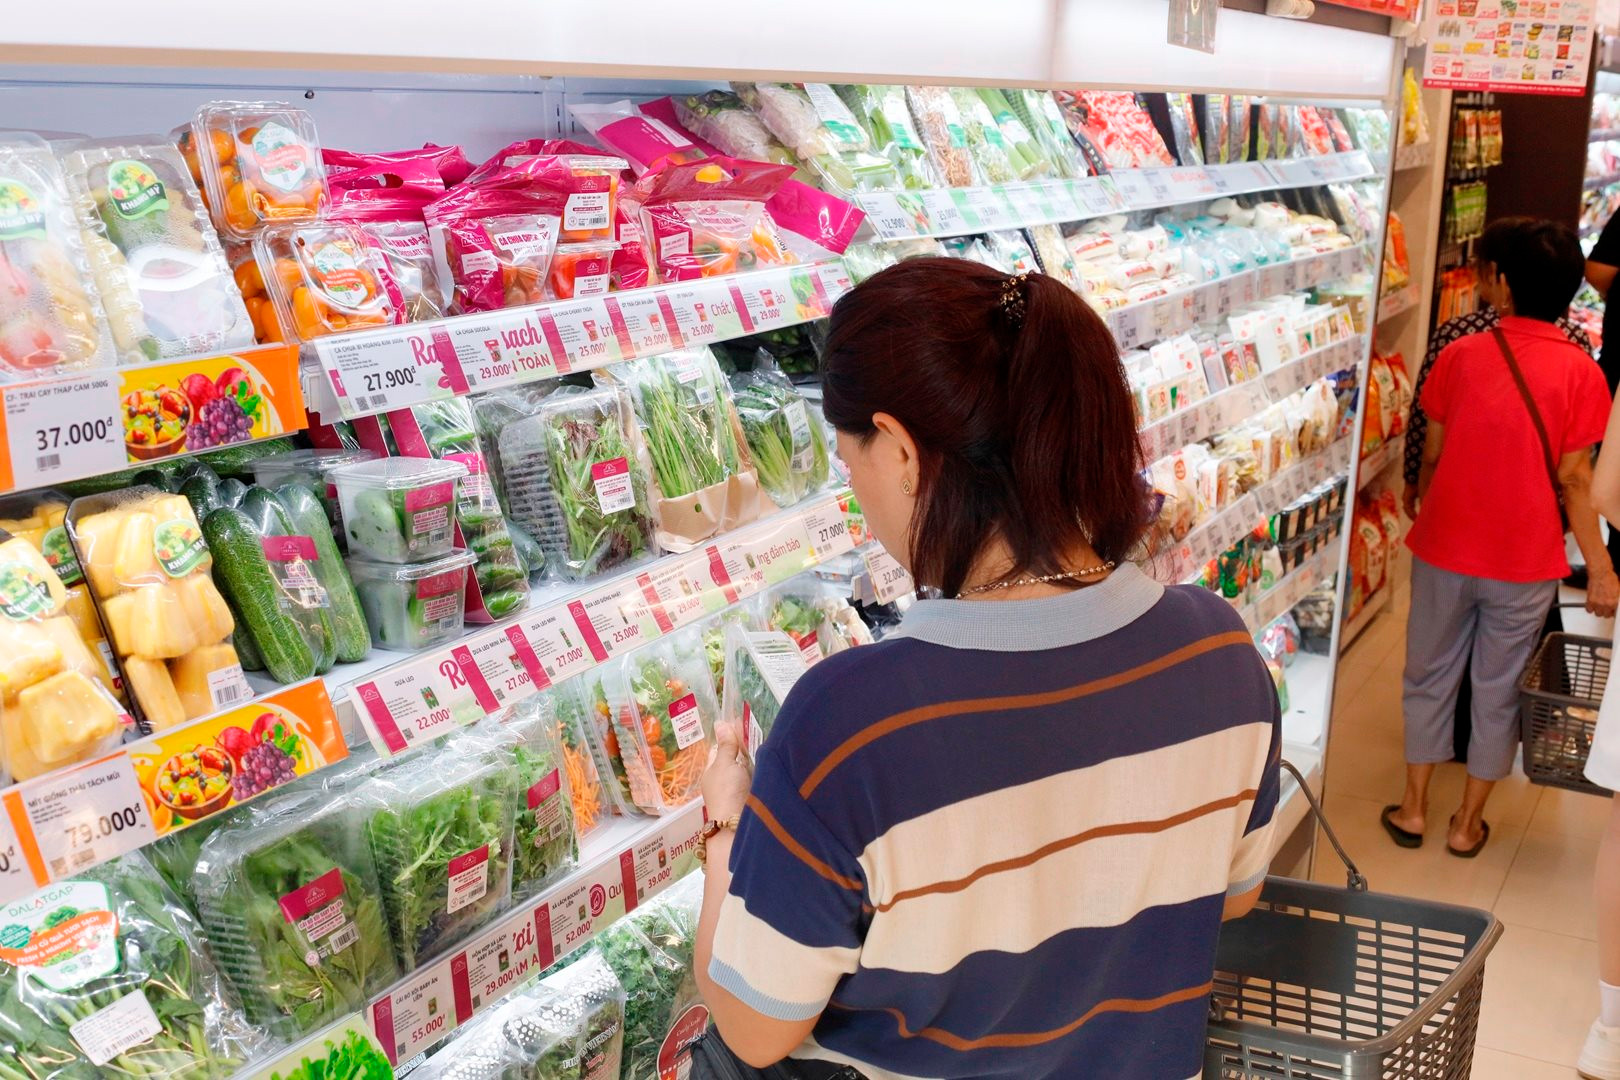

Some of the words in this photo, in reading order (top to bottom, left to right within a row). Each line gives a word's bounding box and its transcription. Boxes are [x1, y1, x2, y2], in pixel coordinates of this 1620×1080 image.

[711, 299, 731, 316] Chất
[518, 352, 551, 371] TOÀN
[505, 672, 531, 691] 27.00
